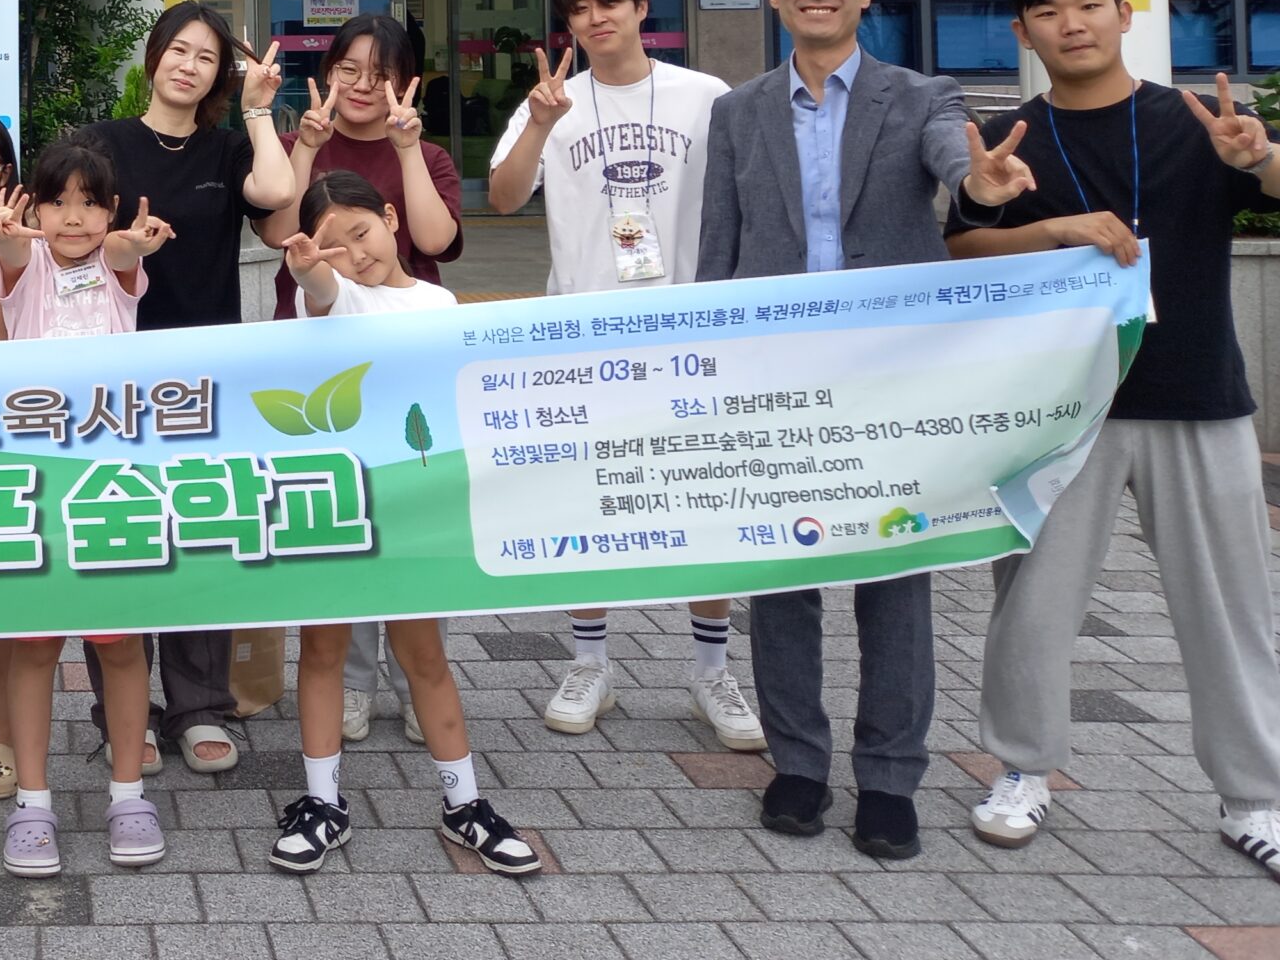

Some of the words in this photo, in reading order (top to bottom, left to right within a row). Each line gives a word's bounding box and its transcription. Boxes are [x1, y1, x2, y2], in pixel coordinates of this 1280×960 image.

[569, 122, 692, 172] UNIVERSITY
[617, 166, 650, 179] 1987
[601, 180, 669, 199] AUTHENTIC
[463, 330, 477, 346] 본
[481, 326, 525, 345] 사업은
[755, 299, 852, 323] 복권위원회의
[857, 292, 898, 313] 지원을
[903, 291, 932, 307] 받아
[935, 282, 1034, 307] 복권기금으로
[1039, 271, 1117, 297] 진행됩니다.
[481, 372, 515, 392] 일시
[532, 365, 594, 388] 2024년
[599, 358, 648, 382] 03월
[671, 353, 718, 378] 10월
[484, 409, 519, 431] 대상
[535, 404, 589, 428] 청소년
[671, 397, 708, 420] 장소
[723, 389, 810, 416] 영남대학교
[815, 389, 834, 408] 외
[492, 442, 577, 467] 신청및문의
[595, 438, 645, 460] 영남대
[650, 429, 772, 456] 발도르프숲학교
[778, 427, 814, 448] 간사
[819, 416, 964, 444] 053-810-4380
[970, 412, 1011, 436] (주중
[1013, 409, 1041, 429] 9시
[596, 467, 645, 486] Email
[659, 456, 863, 486] yuwaldorf@gmail.com
[61, 447, 372, 570] 숲학교
[599, 492, 670, 517] 홈페이지
[686, 479, 921, 512] http://yugreenschool.net
[500, 538, 536, 561] 시행
[592, 530, 688, 554] 영남대학교
[737, 525, 776, 545] 지원
[830, 522, 870, 538] 산림청
